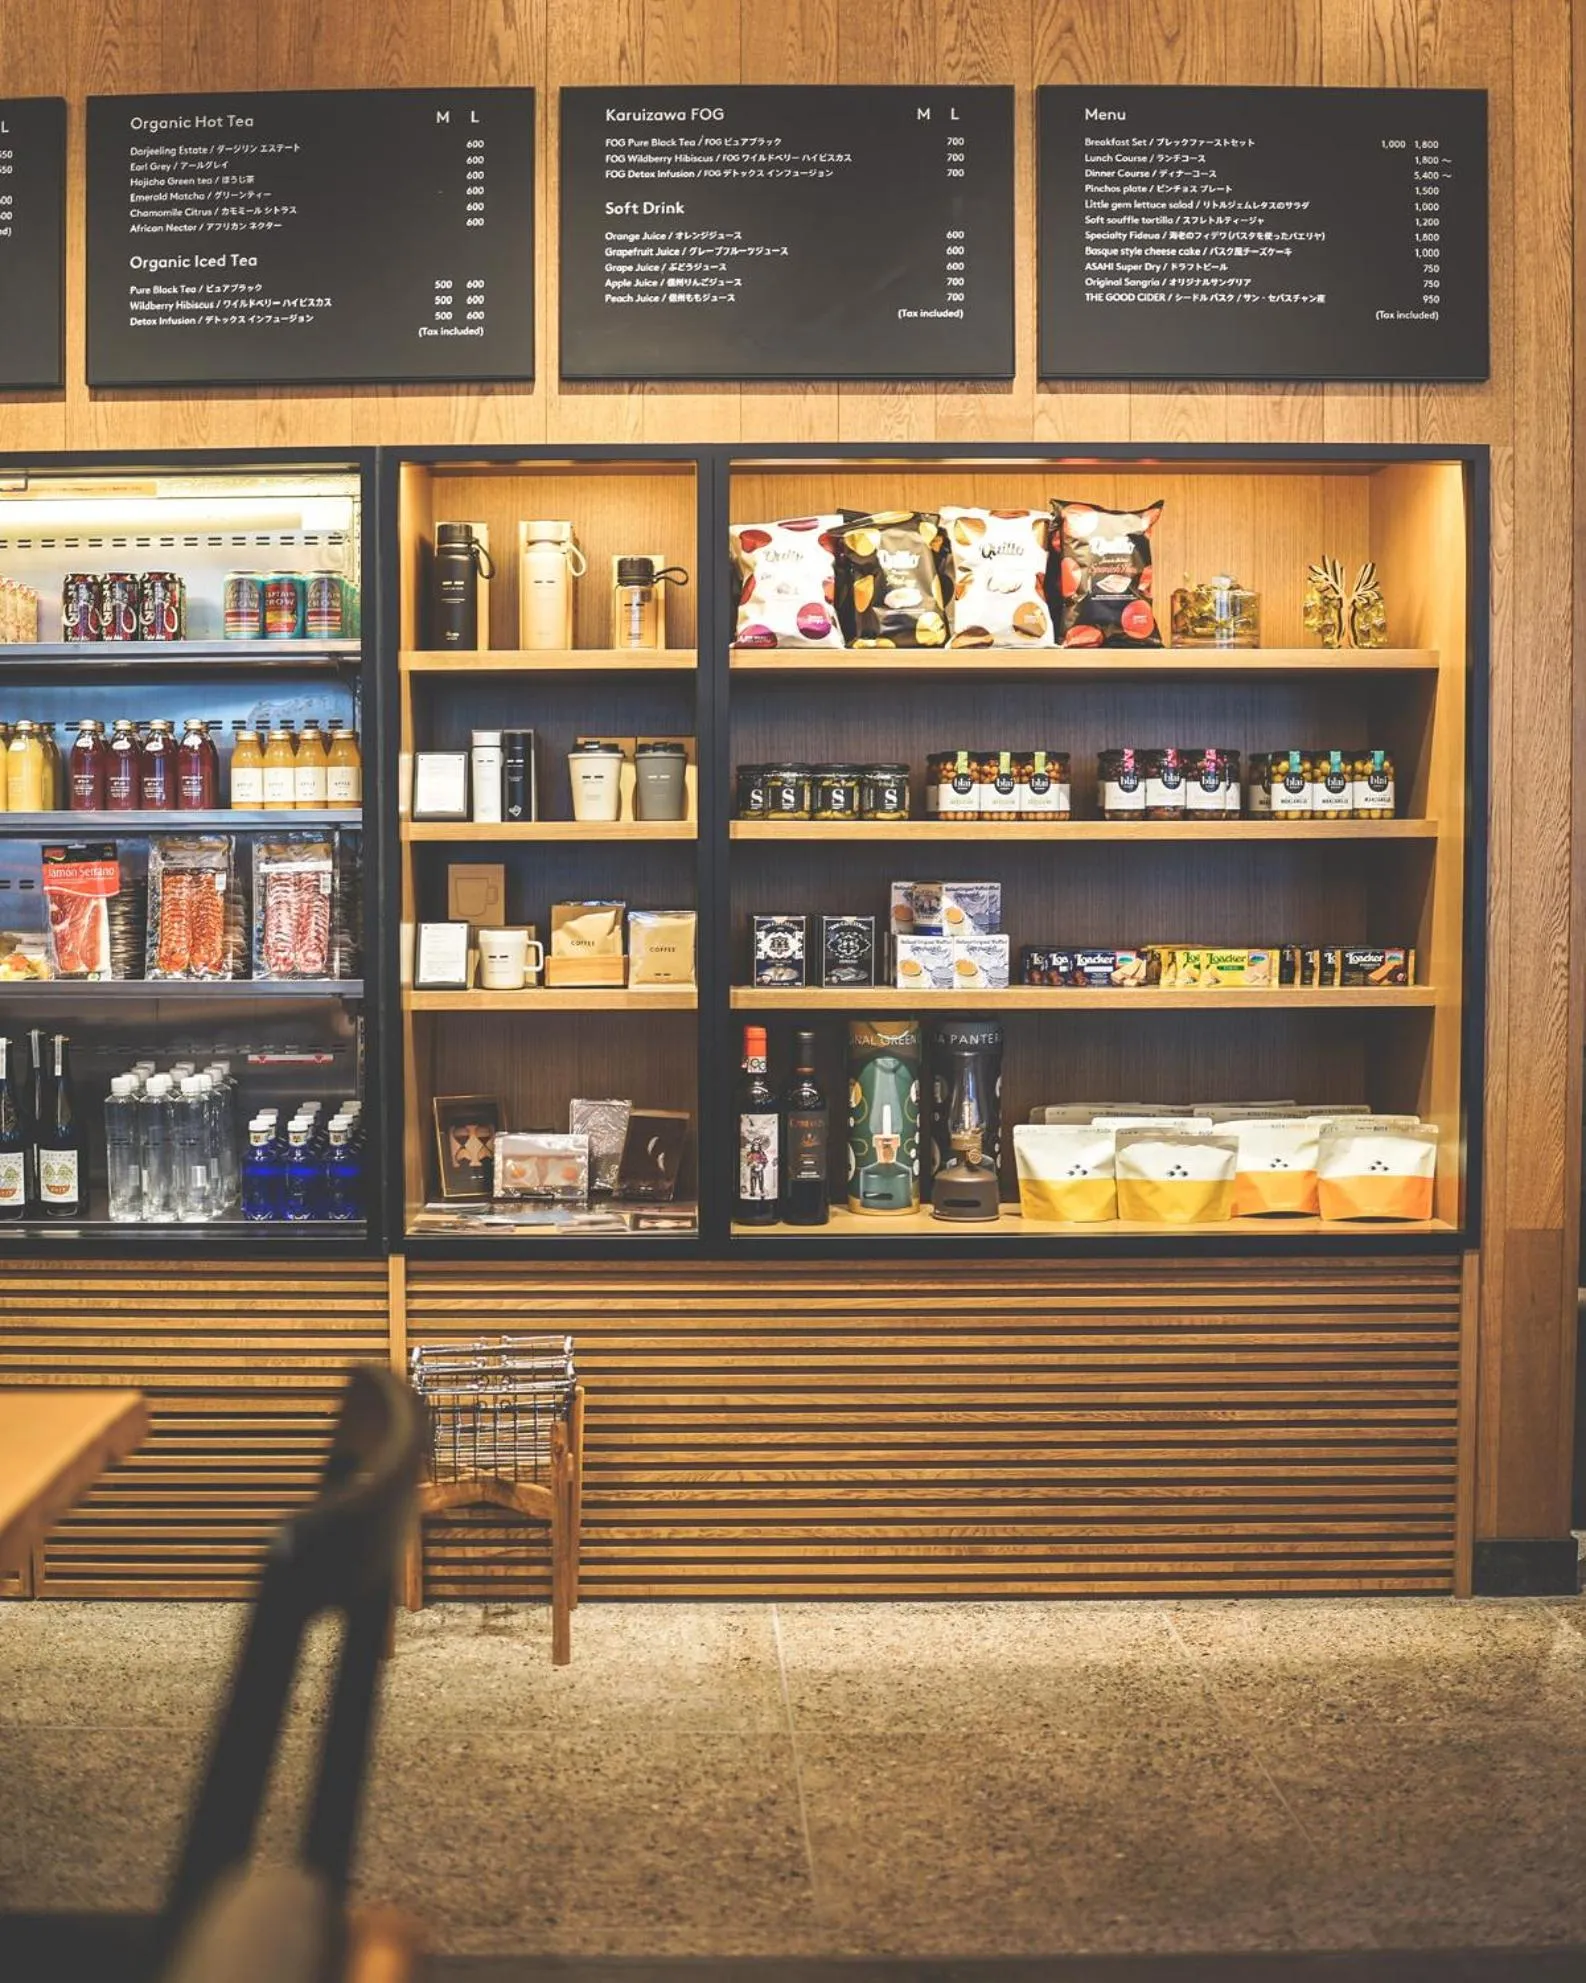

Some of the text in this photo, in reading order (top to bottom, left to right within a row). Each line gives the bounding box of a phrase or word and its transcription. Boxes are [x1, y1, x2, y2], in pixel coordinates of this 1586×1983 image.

[436, 111, 450, 124] M
[471, 110, 480, 124] L
[606, 107, 725, 122] Karuizawa FOG
[917, 107, 931, 120] M
[951, 107, 960, 121] L
[1085, 108, 1126, 121] Menu
[1, 120, 10, 134] L
[130, 114, 254, 133] Organic Hot Tea
[466, 139, 485, 149] 600
[605, 138, 723, 148] FOG Pure Black Tea FOG
[947, 137, 965, 146] 700
[1084, 137, 1147, 147] Breakfast Set
[1381, 140, 1407, 149] 1,000
[1414, 140, 1439, 150] 1,800
[130, 145, 209, 158] Darjeeling Estate
[466, 155, 485, 165] 600
[605, 154, 741, 165] FOG Wildberry Hibiscus FOG
[947, 153, 965, 162] 700
[1084, 153, 1148, 163] Lunch Course
[1415, 155, 1440, 166] 1,800
[130, 162, 172, 173] Earl Grey
[947, 168, 965, 177] 700
[1084, 168, 1151, 178] Dinner Course
[466, 171, 485, 180] 600
[605, 169, 723, 179] FOG Detox Infusion FOG
[1413, 171, 1440, 181] 5,400
[167, 176, 195, 186] Green
[197, 177, 213, 185] tea
[466, 186, 485, 196] 600
[1084, 184, 1148, 195] Pinchos plate
[1415, 186, 1440, 196] 1,500
[130, 191, 205, 203] Emerald Matcha
[466, 202, 485, 212] 600
[605, 201, 685, 215] Soft Drink
[1084, 199, 1110, 209] Little
[1111, 202, 1133, 212] gem
[1133, 199, 1167, 210] lettuce
[1414, 202, 1440, 212] 1,000
[129, 207, 213, 218] Chamomile Citrus
[466, 217, 485, 227] 600
[1084, 215, 1105, 225] Soft
[1415, 217, 1440, 228] 1,200
[129, 224, 164, 233] African
[604, 231, 667, 243] Orange Juice
[946, 230, 965, 240] 600
[1085, 230, 1128, 242] Specialty
[1415, 233, 1440, 243] 1,800
[604, 246, 681, 259] Grapefruit Juice
[946, 245, 965, 255] 600
[1084, 246, 1119, 258] Basque
[1120, 246, 1143, 258] style
[1144, 246, 1177, 256] cheese
[1415, 248, 1440, 259] 1,000
[129, 253, 258, 273] Organic Iced Tea
[604, 263, 660, 274] Grape Juice
[946, 262, 965, 271] 600
[1084, 262, 1162, 274] ASAHI Super Dry
[1423, 264, 1441, 273] 750
[434, 280, 453, 289] 500
[466, 279, 485, 289] 600
[604, 278, 659, 290] Apple Juice
[947, 277, 965, 287] 700
[1084, 277, 1161, 289] Original Sangria
[1423, 279, 1441, 289] 750
[130, 284, 197, 295] Pure Black Tea
[434, 295, 453, 305] 500
[466, 294, 485, 305] 600
[604, 293, 661, 303] Peach Juice
[947, 292, 965, 302] 700
[1084, 292, 1167, 302] THE GOOD CIDER
[1422, 294, 1441, 304] 950
[129, 300, 215, 312] Wildberry Hibiscus
[434, 311, 453, 321] 500
[466, 311, 485, 320] 600
[898, 308, 964, 320] (Tax included)
[1375, 310, 1439, 321] (Tax included)
[129, 316, 197, 326] Detox Infusion
[418, 326, 485, 338] (Tax included)
[954, 778, 972, 787] blai
[997, 776, 1013, 787] blai
[1031, 777, 1049, 788] blai
[1120, 775, 1138, 786] blai
[1163, 772, 1180, 783] blai
[1201, 775, 1219, 785] blai
[1285, 776, 1304, 787] blai
[1327, 776, 1345, 787] blai
[1369, 775, 1387, 786] blai
[1074, 953, 1115, 967] Loacker
[1206, 953, 1247, 965] Loacker
[1344, 952, 1384, 965] Loacker
